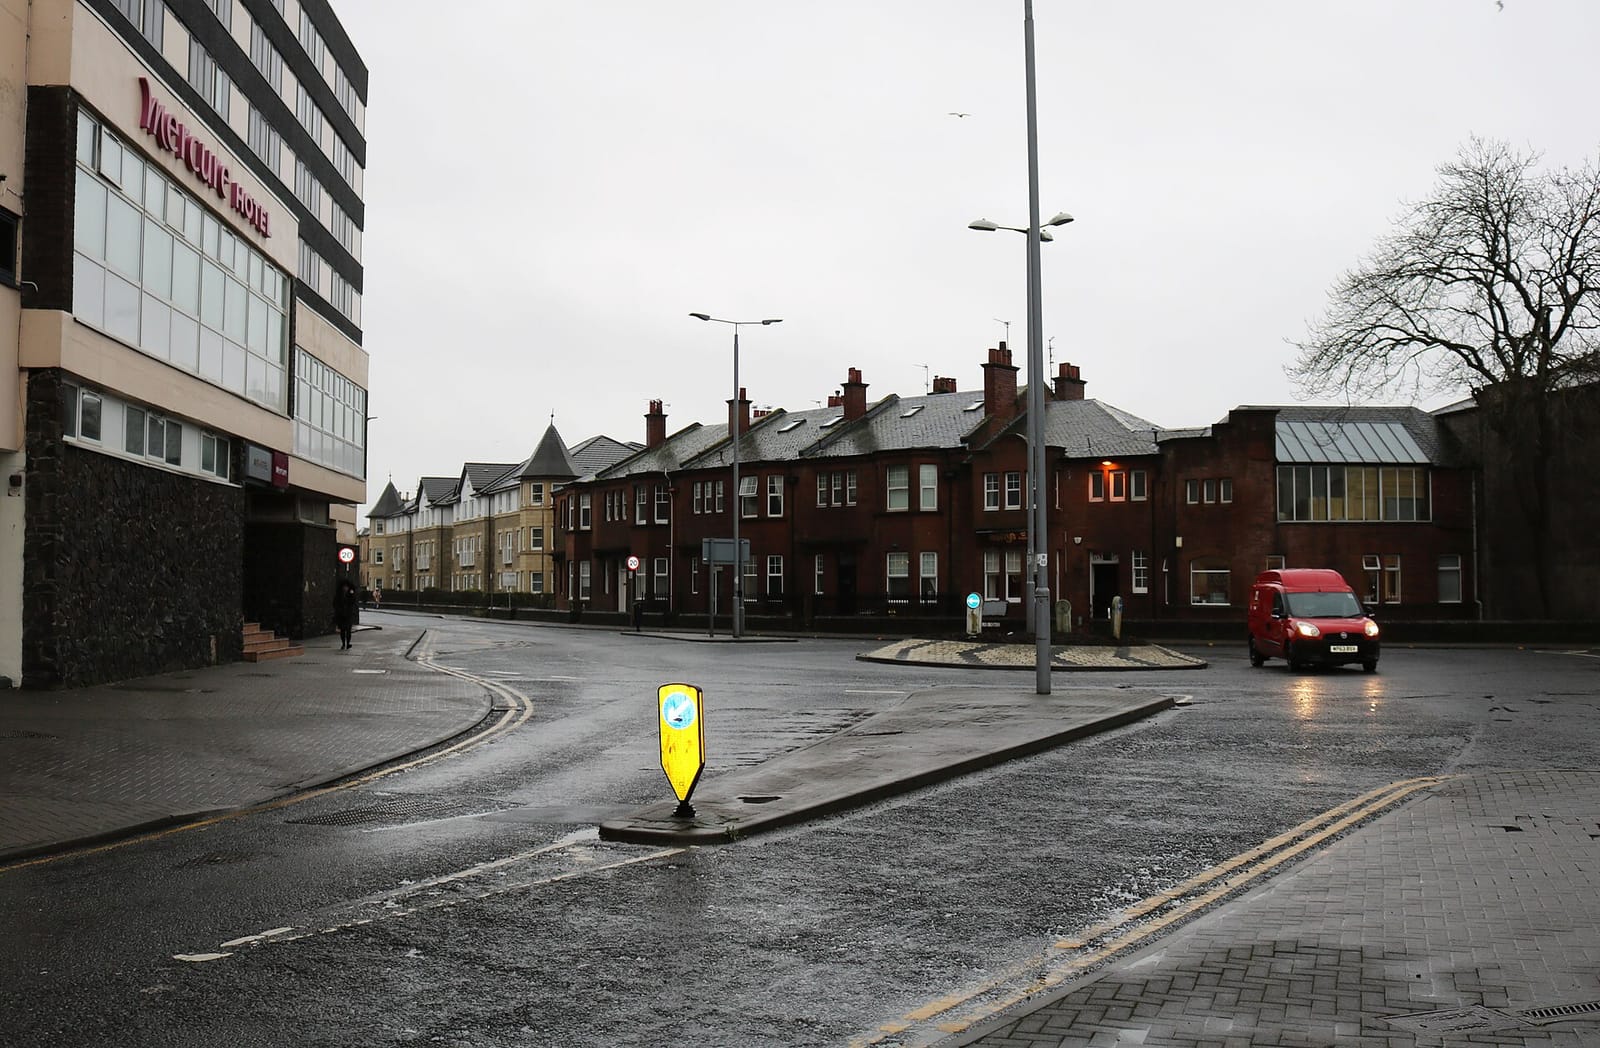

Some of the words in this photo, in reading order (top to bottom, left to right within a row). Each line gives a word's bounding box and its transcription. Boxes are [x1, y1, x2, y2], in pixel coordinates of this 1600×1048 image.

[230, 182, 272, 239] HOTEL
[341, 551, 353, 560] 20
[629, 559, 638, 567] 20
